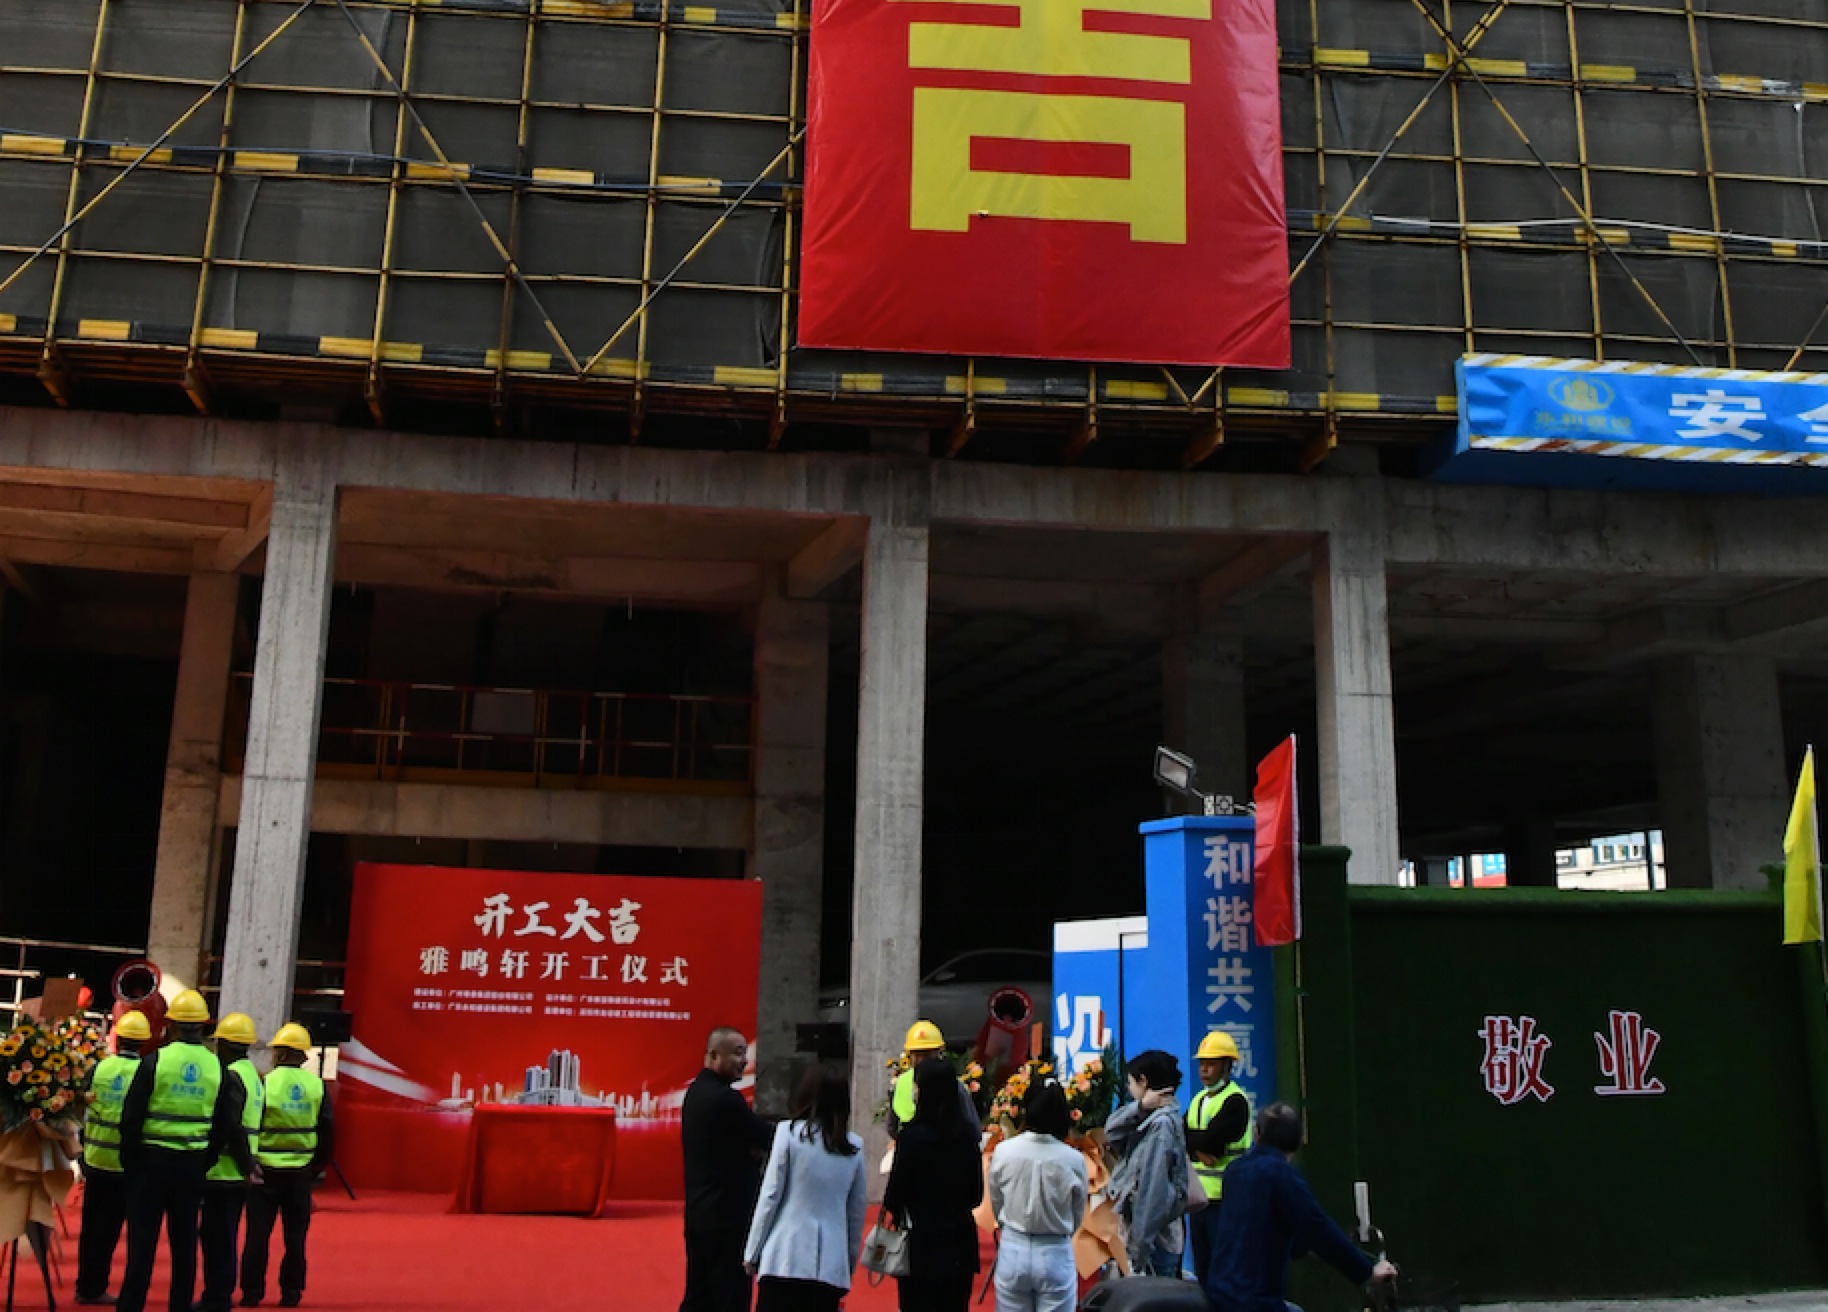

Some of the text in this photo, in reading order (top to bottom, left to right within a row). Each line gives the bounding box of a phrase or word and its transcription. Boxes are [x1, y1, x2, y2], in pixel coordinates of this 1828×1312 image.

[473, 892, 643, 945] 开工大吉
[419, 945, 690, 987] 雅鸣轩开工仪式
[1477, 1009, 1666, 1105] 敬业
